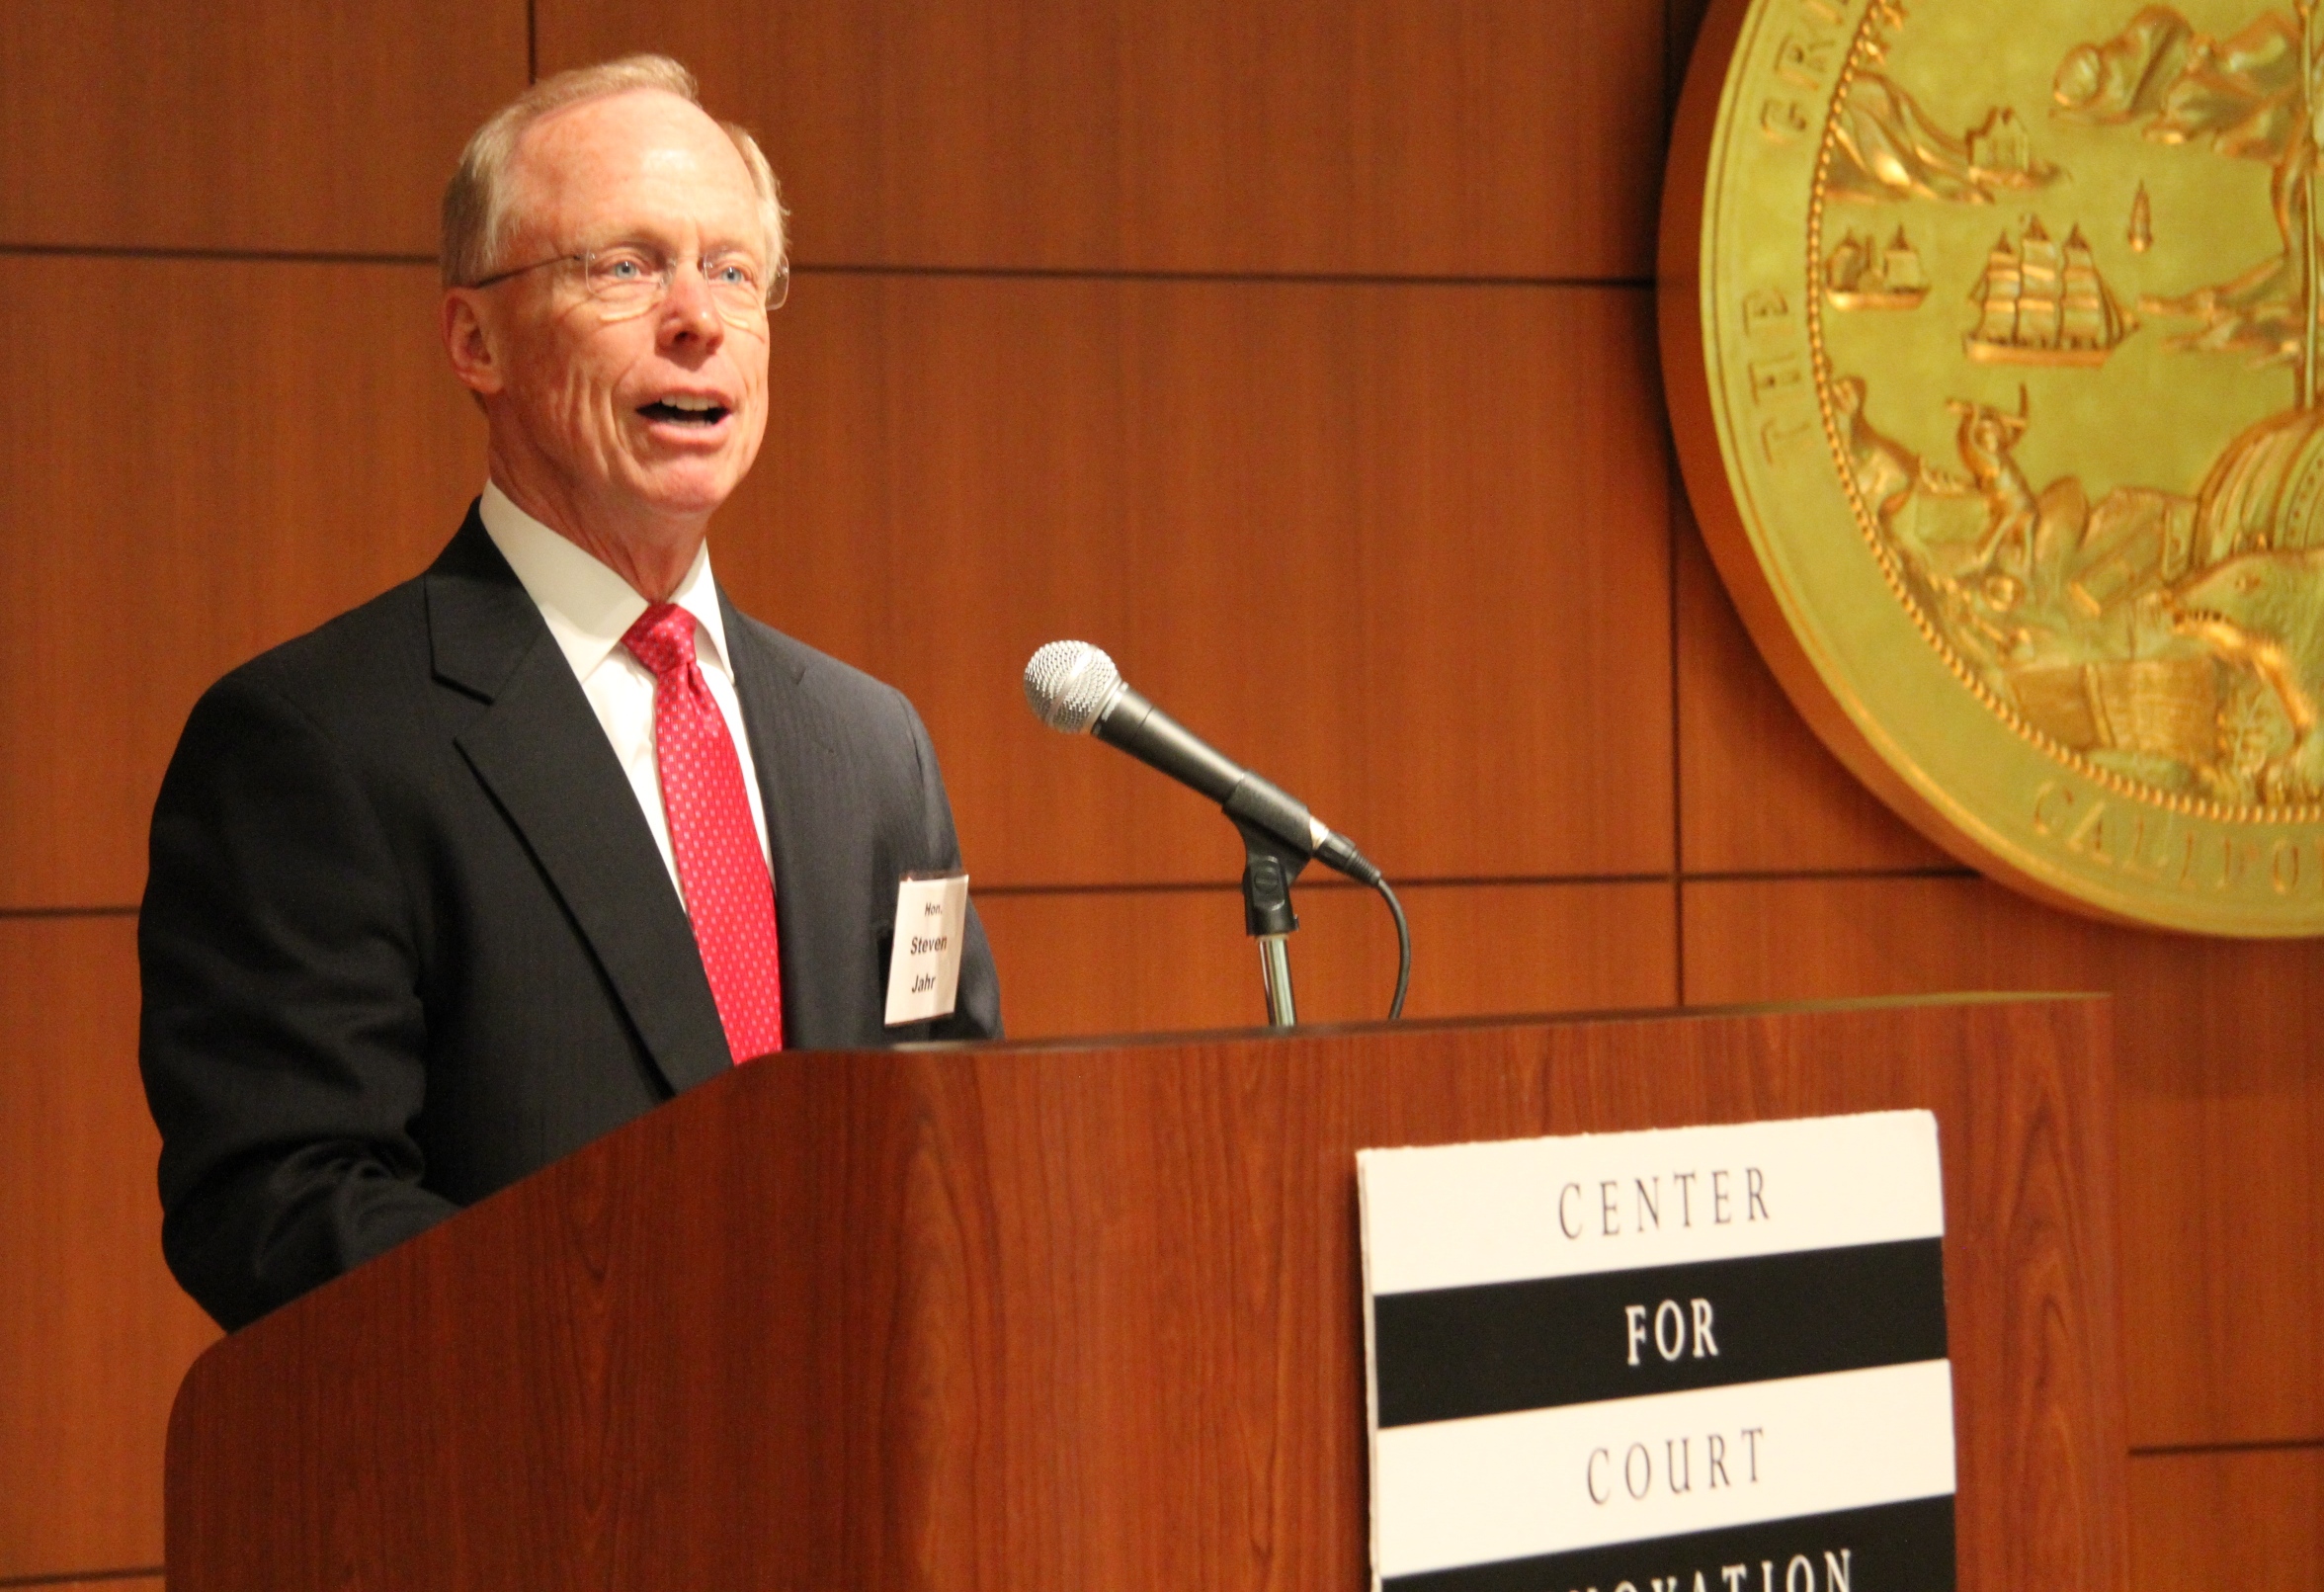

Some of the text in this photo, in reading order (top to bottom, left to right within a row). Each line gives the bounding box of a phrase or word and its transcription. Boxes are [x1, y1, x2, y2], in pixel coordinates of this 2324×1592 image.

[925, 902, 943, 916] Hon.
[911, 937, 947, 955] Steven
[912, 971, 936, 993] Jahr
[1558, 1167, 1770, 1240] CENTER
[1625, 1299, 1718, 1366] FOR
[1586, 1427, 1766, 1505] COURT
